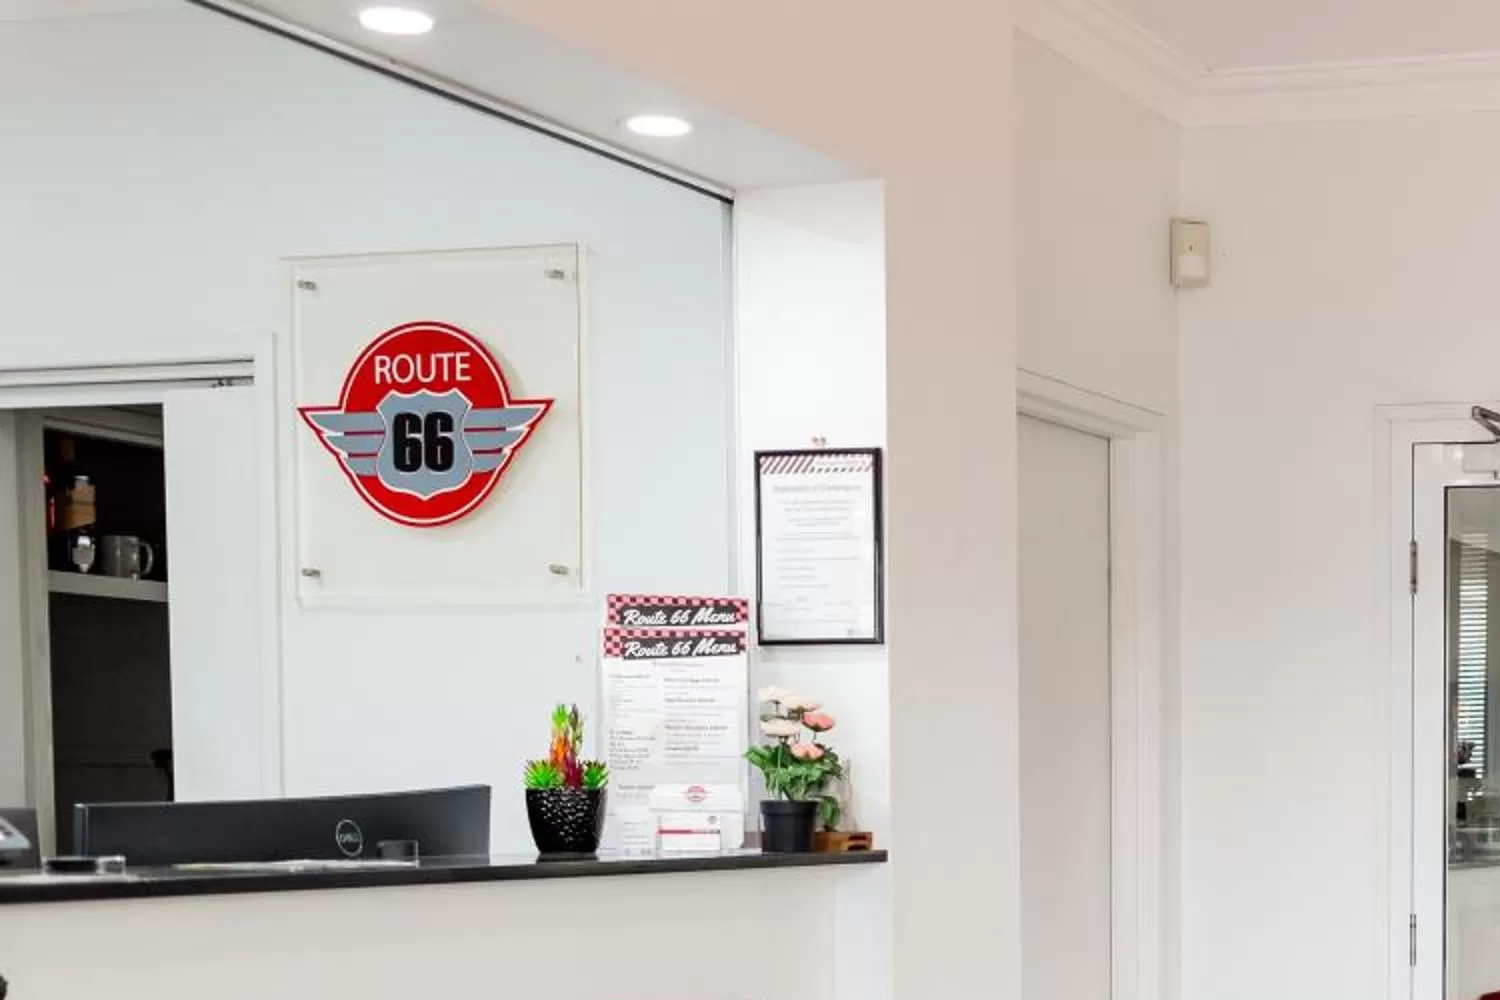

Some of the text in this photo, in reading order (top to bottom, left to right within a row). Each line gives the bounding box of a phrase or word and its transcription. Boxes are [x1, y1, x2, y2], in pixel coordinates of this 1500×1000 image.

[374, 352, 472, 384] ROUTE
[393, 411, 454, 473] 66
[623, 606, 737, 625] Route 66 Menu
[624, 638, 738, 657] Route 66 Menu
